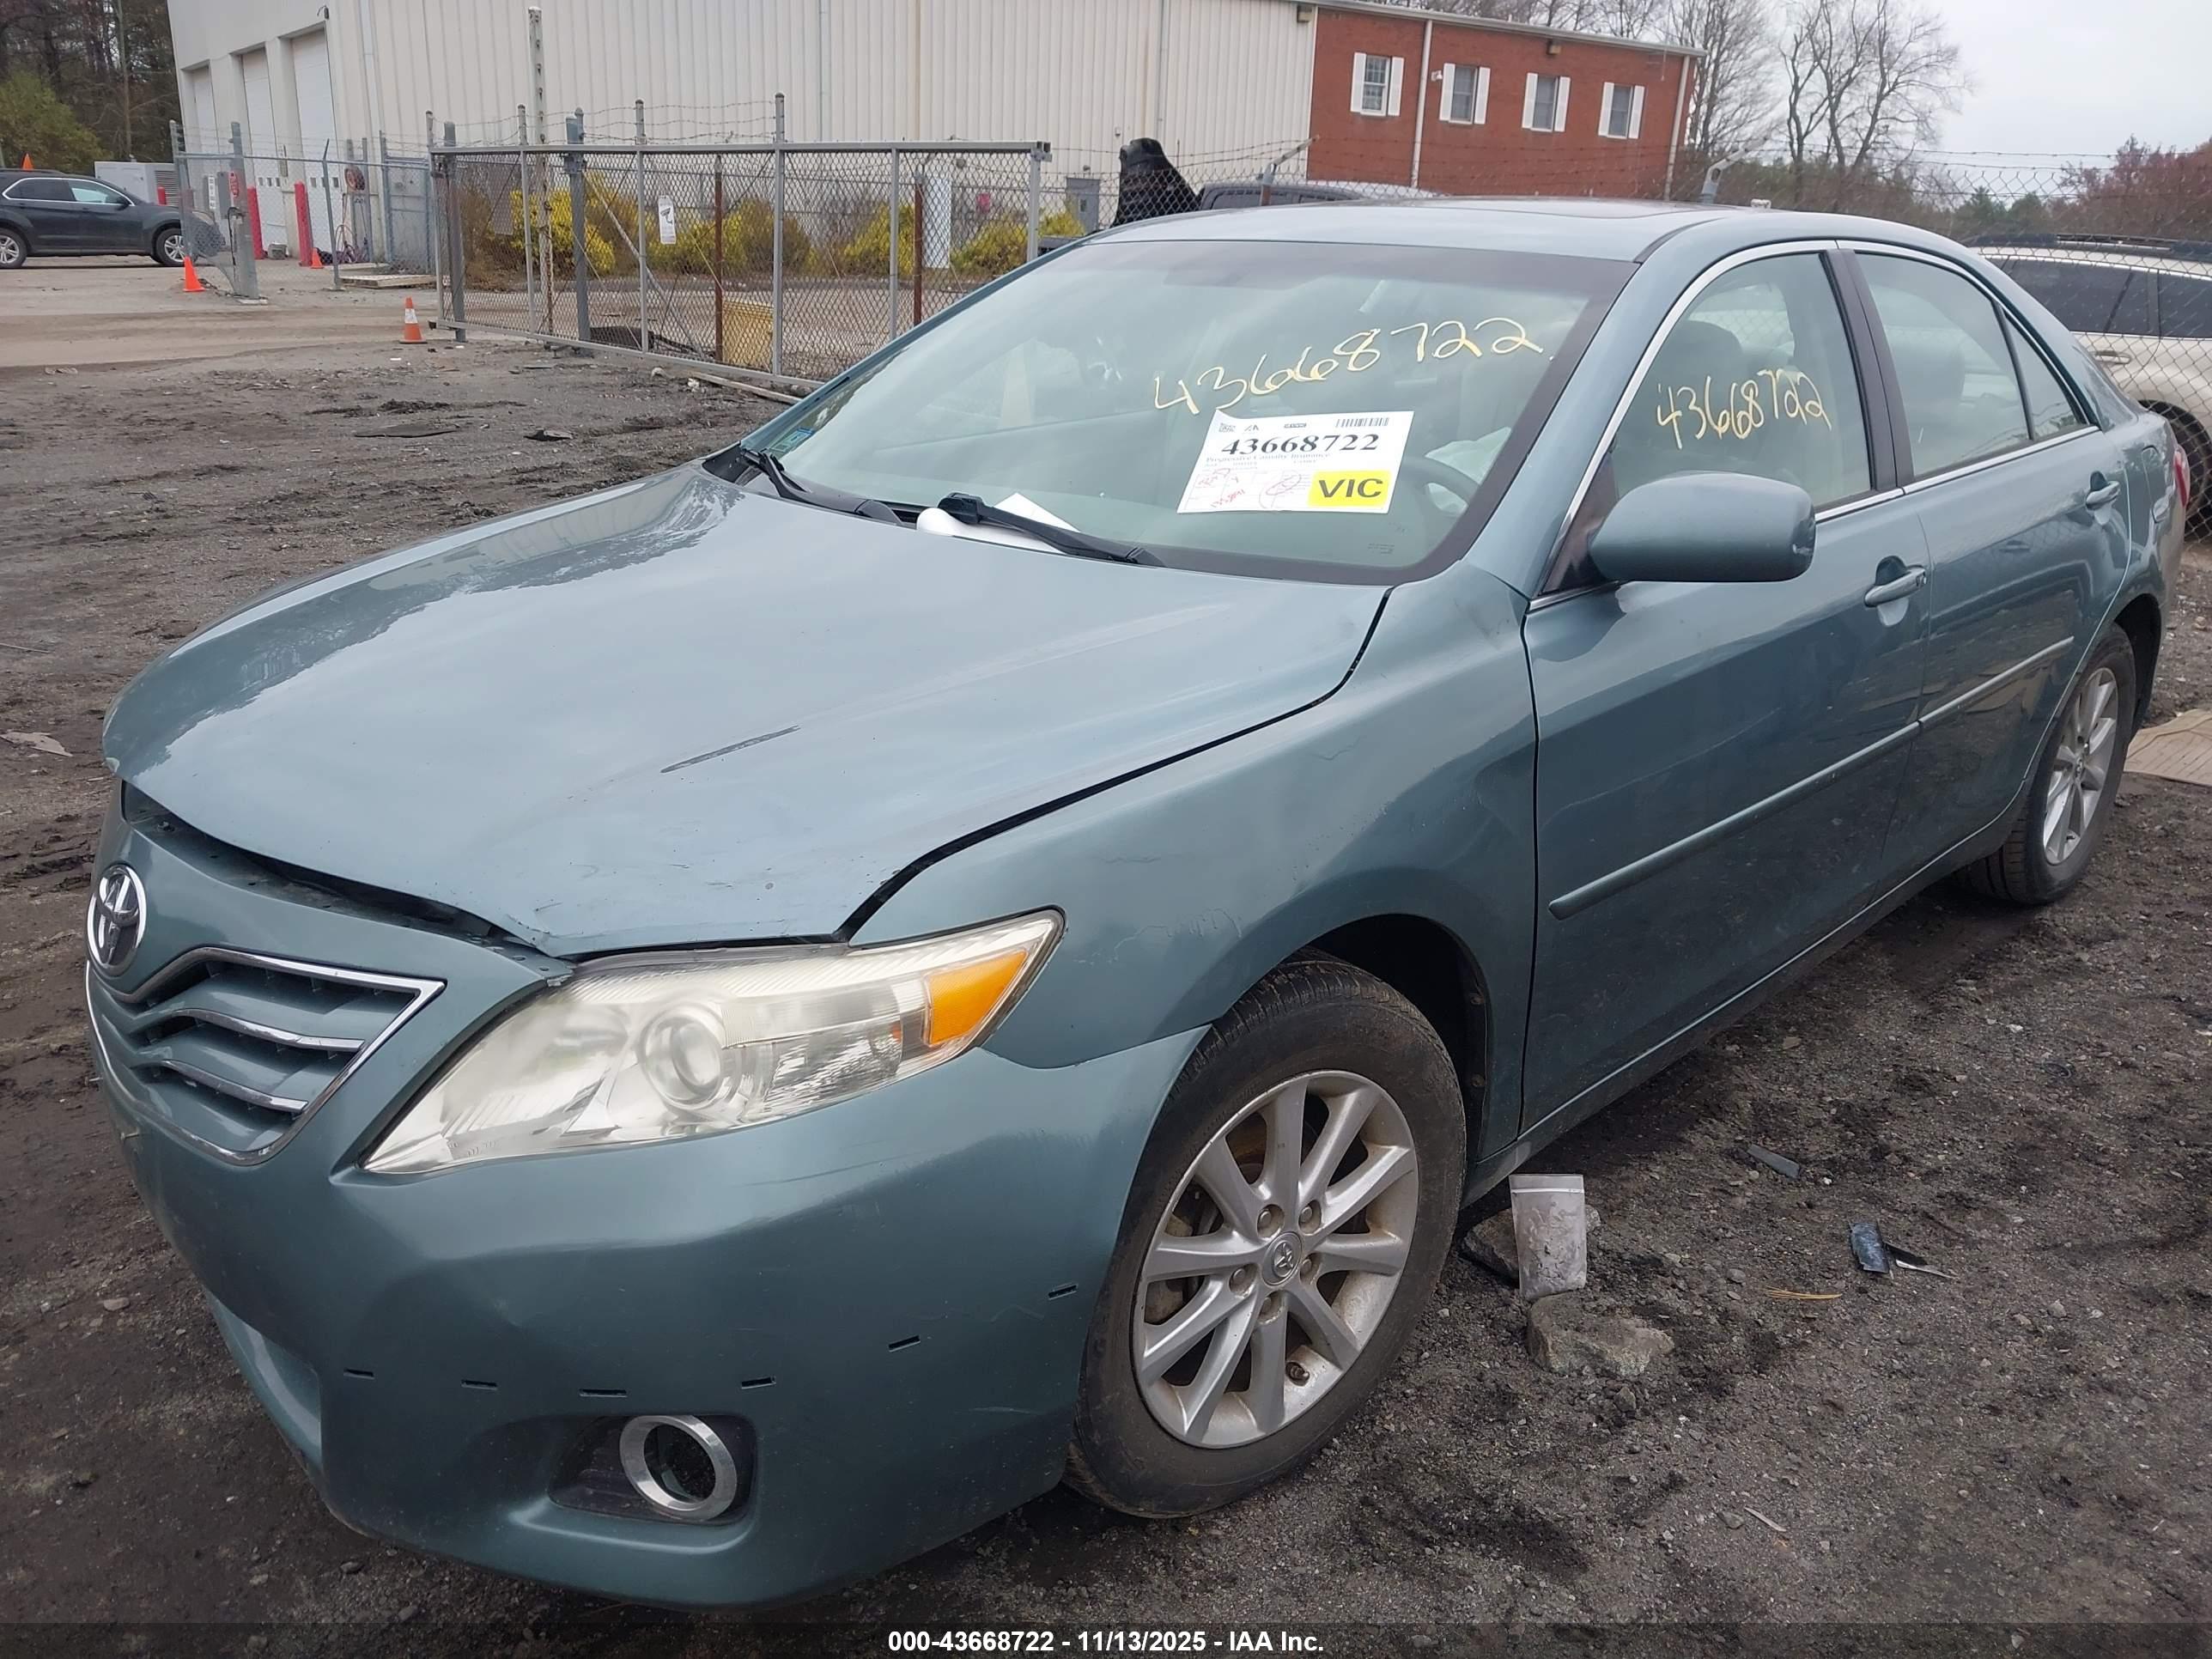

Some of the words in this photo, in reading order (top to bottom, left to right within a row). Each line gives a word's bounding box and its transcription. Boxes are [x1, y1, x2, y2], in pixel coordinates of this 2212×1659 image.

[1656, 368, 1832, 450] 43668722
[1221, 434, 1379, 455] 43668722
[1318, 477, 1384, 499] VIC
